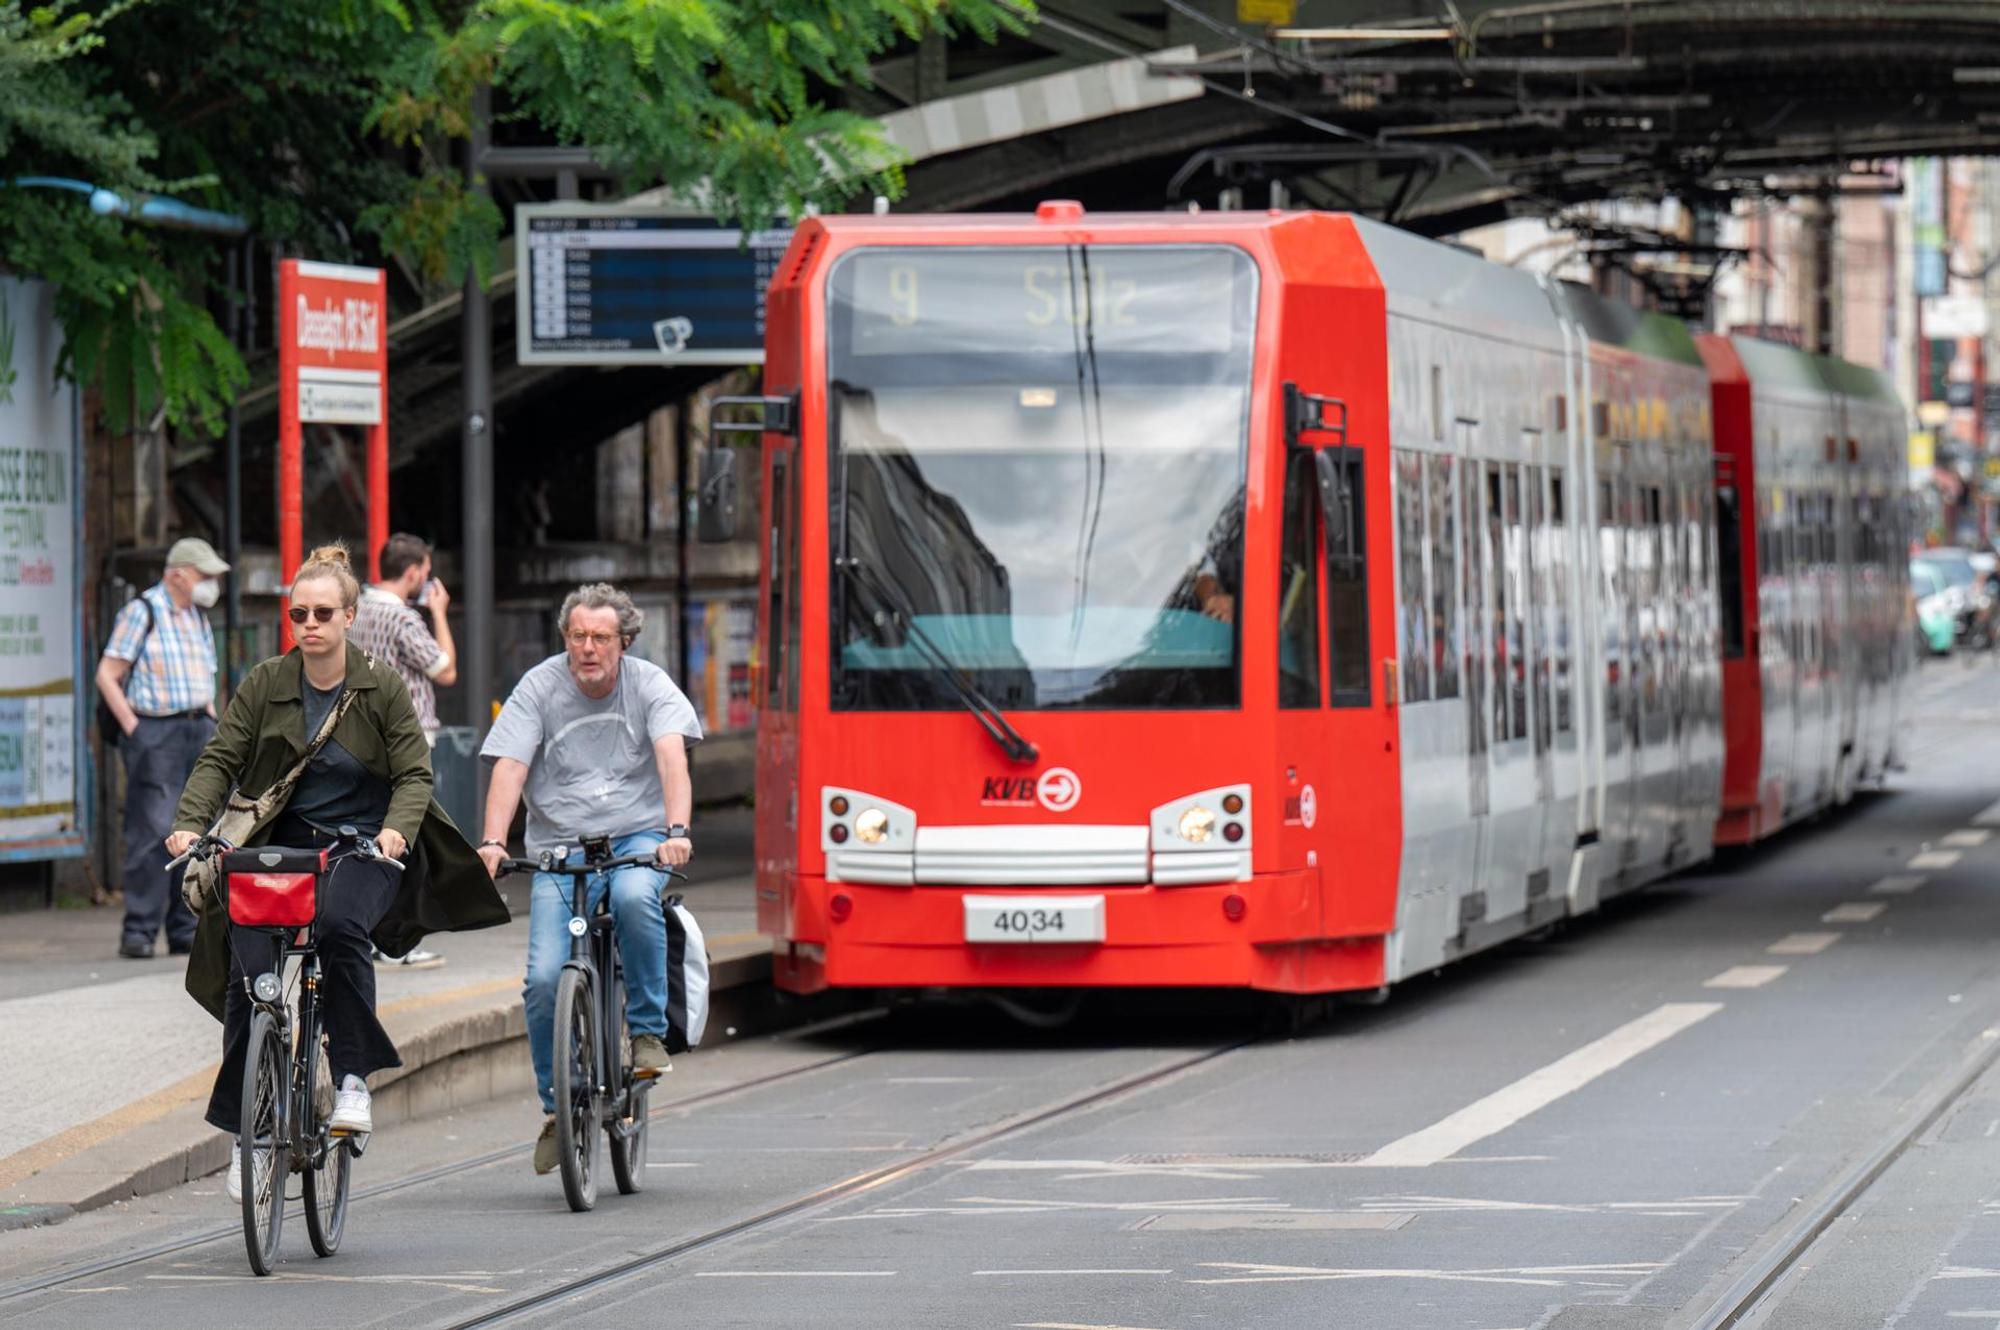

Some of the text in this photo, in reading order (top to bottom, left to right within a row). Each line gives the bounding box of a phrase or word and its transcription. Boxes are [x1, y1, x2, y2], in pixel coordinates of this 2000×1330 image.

[889, 263, 918, 327] 9
[981, 776, 1037, 800] KVB
[994, 909, 1064, 932] 4034
